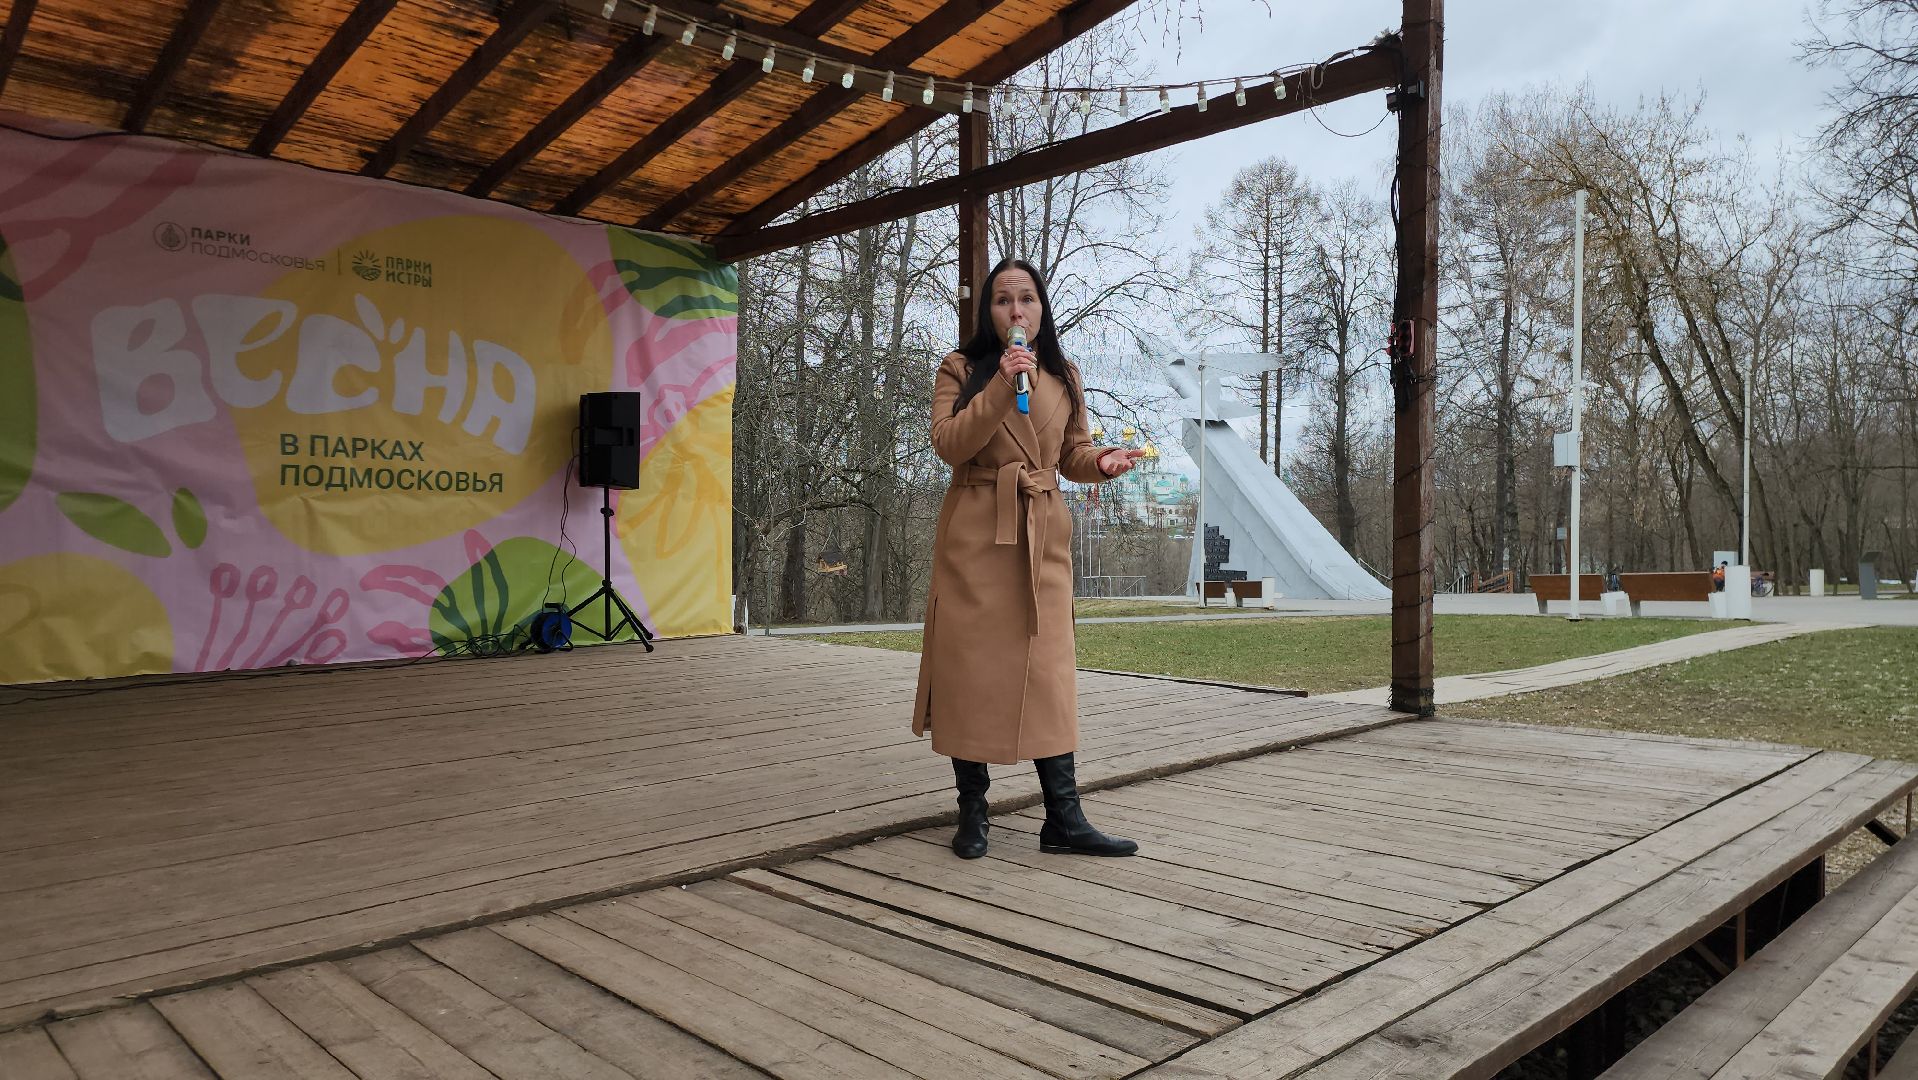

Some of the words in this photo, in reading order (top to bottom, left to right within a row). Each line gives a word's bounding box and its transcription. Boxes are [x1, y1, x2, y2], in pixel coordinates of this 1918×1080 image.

[190, 227, 251, 246] ПАРКИ
[190, 241, 326, 272] ПОДМОСКОВЬЯ
[385, 256, 432, 275] ПАРКИ
[385, 269, 432, 288] ИСТРЫ
[279, 433, 300, 456] В
[309, 434, 425, 462] ПАРКАХ
[280, 464, 504, 493] ПОДМОСКОВЬЯ
